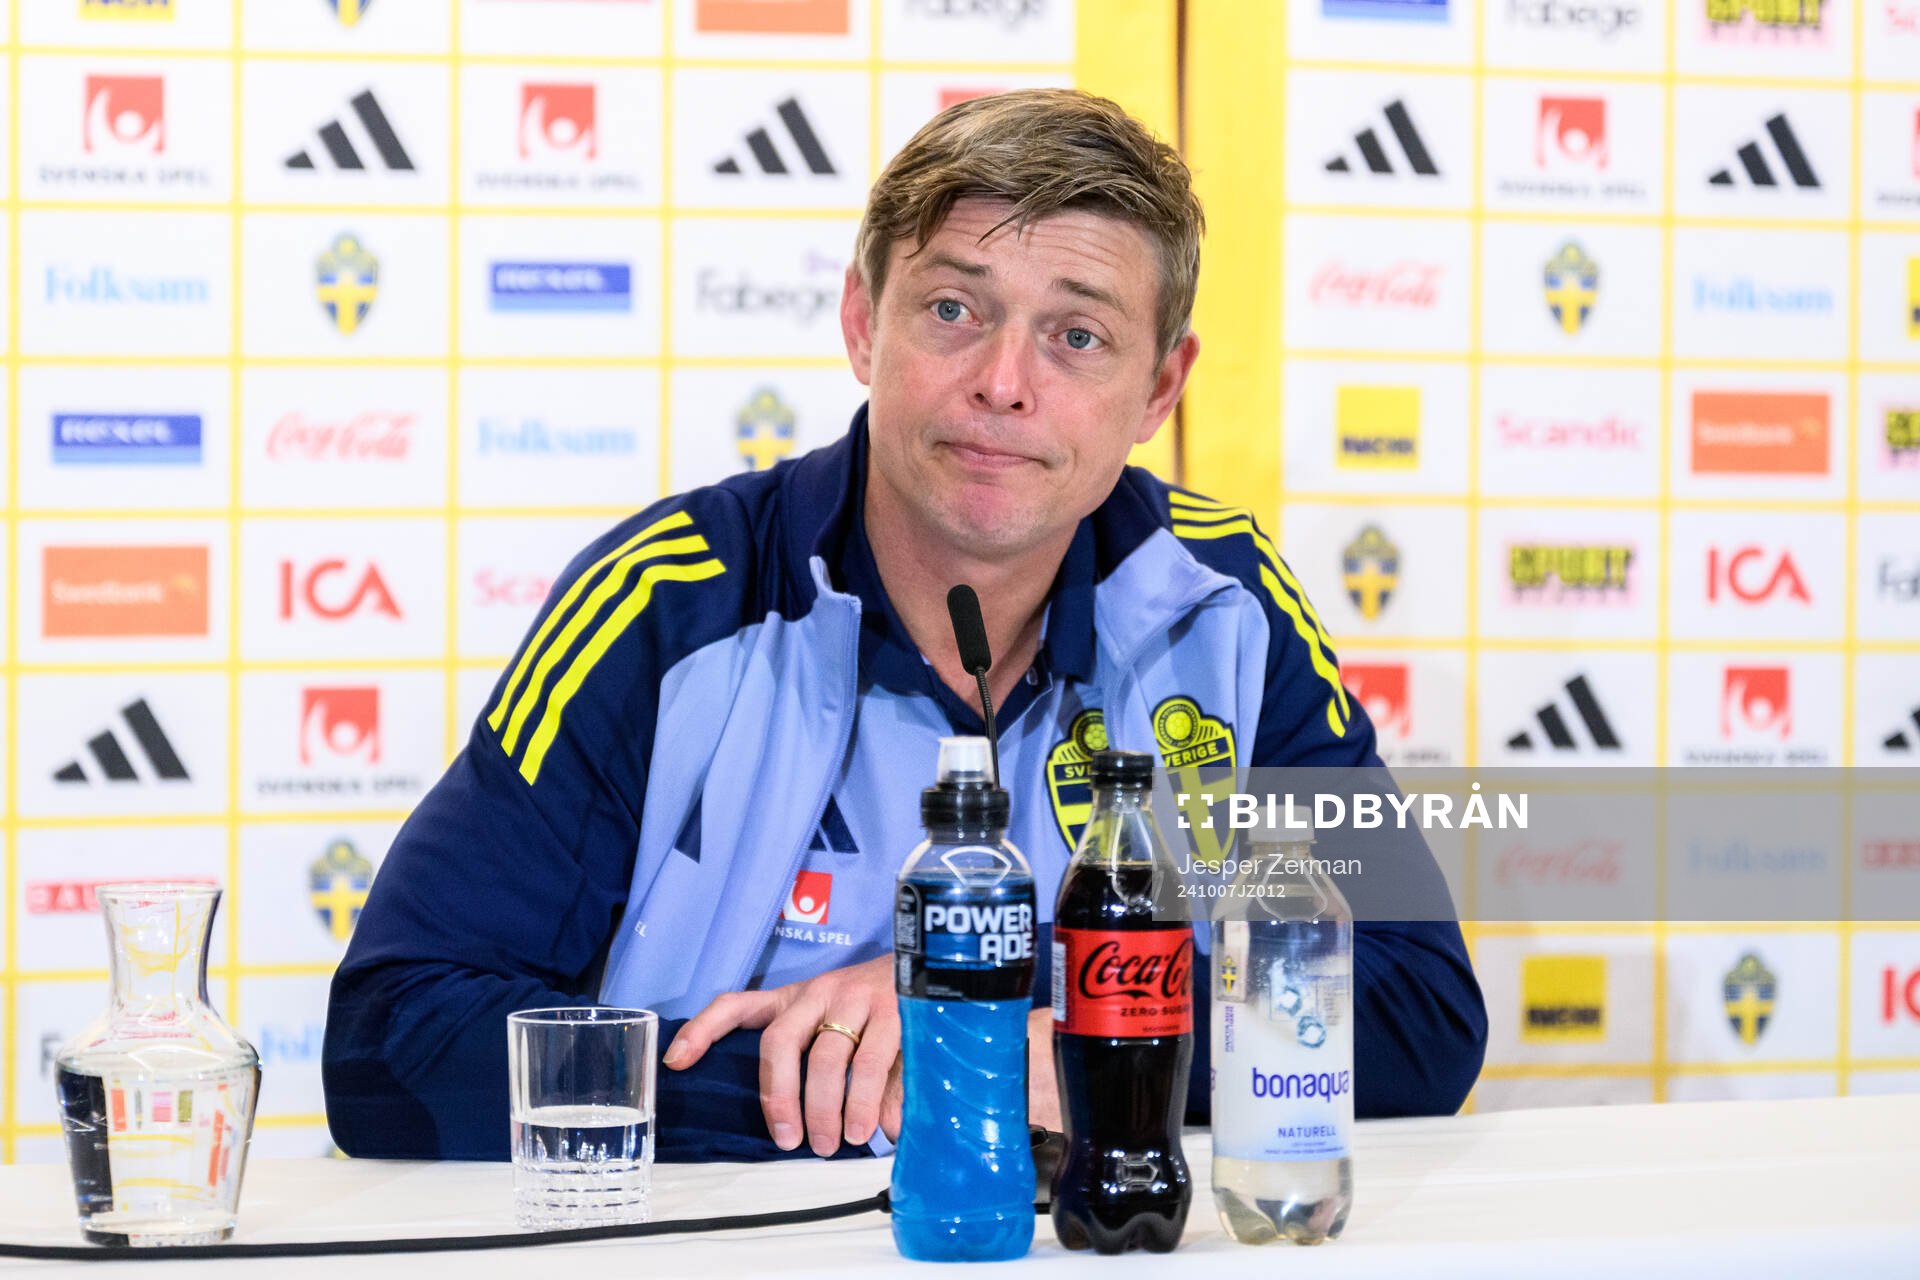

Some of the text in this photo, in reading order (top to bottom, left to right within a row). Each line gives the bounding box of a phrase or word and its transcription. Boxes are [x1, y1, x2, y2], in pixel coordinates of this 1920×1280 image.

[278, 557, 403, 622] ICA
[1707, 545, 1812, 605] ICA
[925, 905, 1033, 934] POWER
[818, 932, 852, 946] SPEL
[980, 932, 1034, 961] ADE
[1120, 1007, 1158, 1017] ZERO
[1252, 1067, 1349, 1103] bonaqua
[1277, 1126, 1337, 1138] NATURELL
